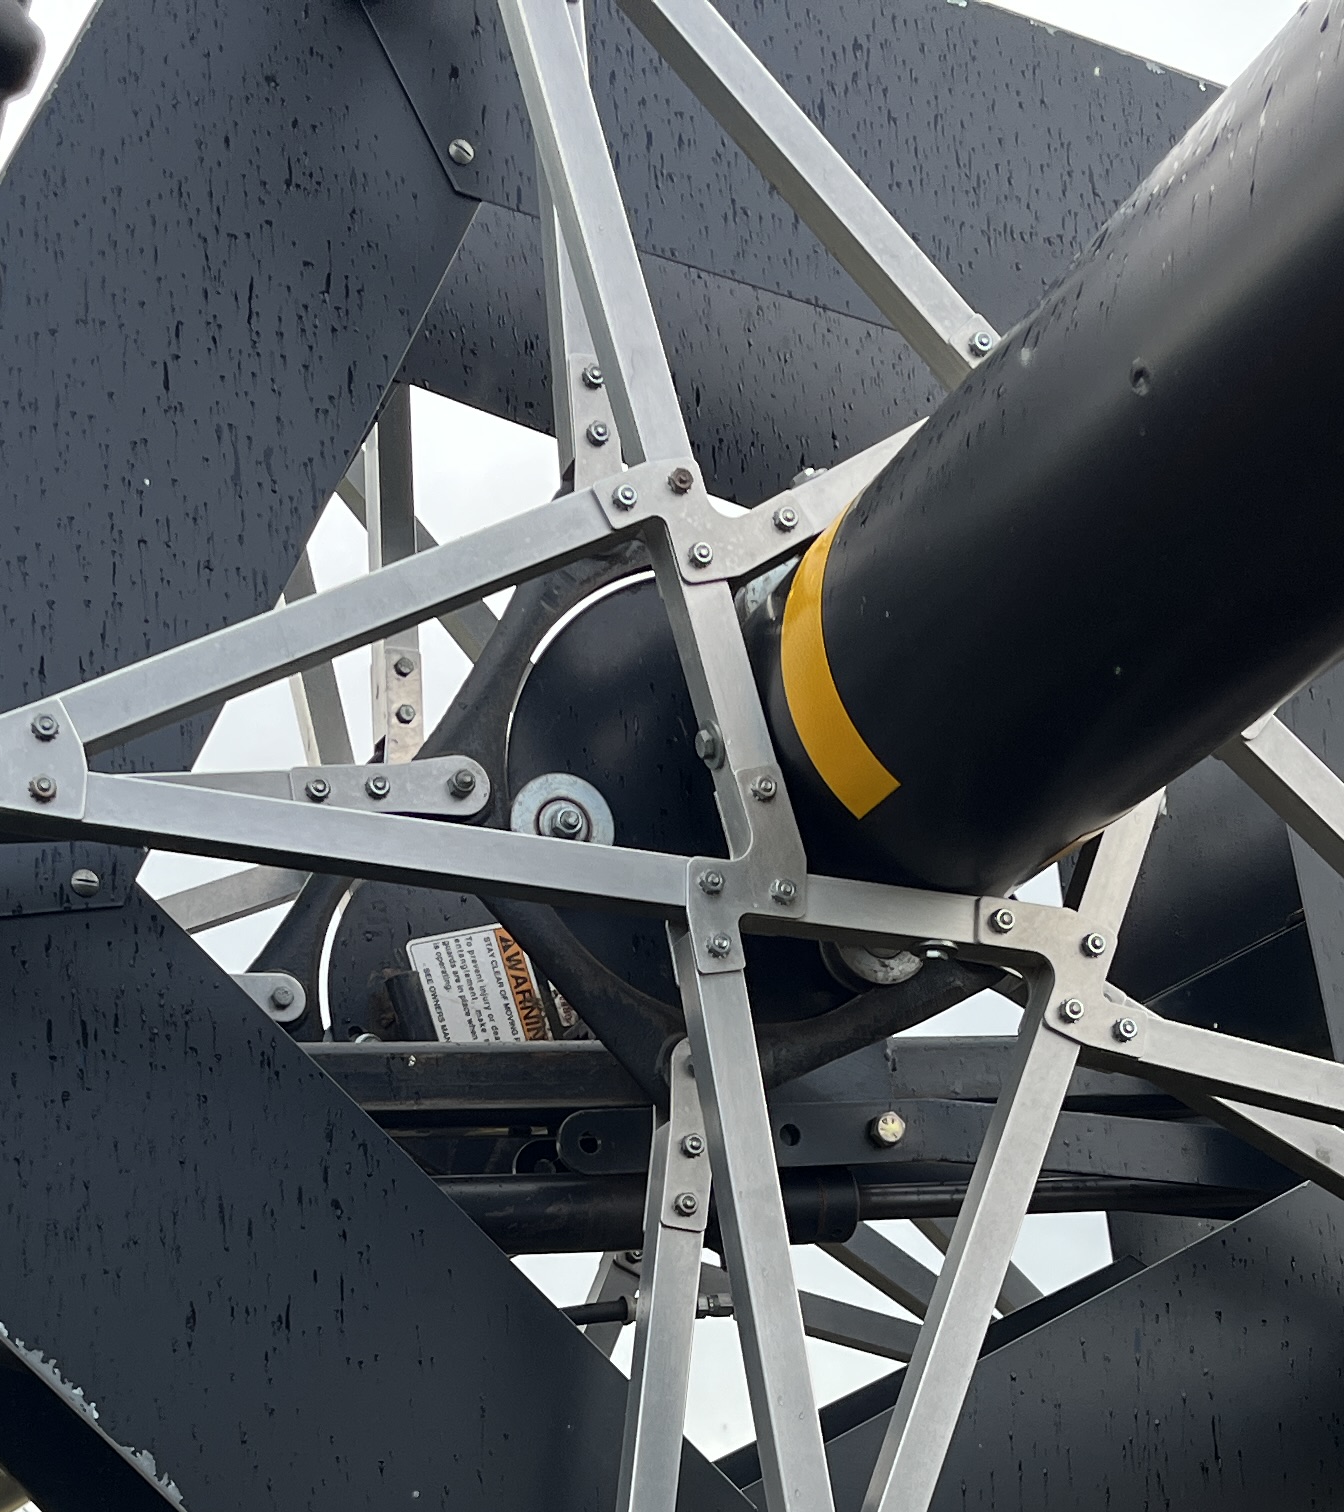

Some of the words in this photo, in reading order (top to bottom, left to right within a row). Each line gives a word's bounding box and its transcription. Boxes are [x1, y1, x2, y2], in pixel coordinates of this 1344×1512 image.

[433, 941, 441, 950] is
[465, 936, 474, 948] To
[483, 936, 496, 959] STAY
[442, 940, 458, 969] guards
[467, 949, 484, 983] prevent
[434, 951, 454, 993] operating.
[452, 970, 461, 983] are
[490, 959, 505, 988] CLEAR
[423, 967, 434, 985] SEE
[429, 985, 446, 1023] OWNERS
[457, 984, 465, 993] in
[478, 985, 493, 1011] injury
[499, 989, 509, 1001] OF
[458, 994, 472, 1017] place
[467, 1018, 479, 1041] when
[475, 1009, 488, 1033] make
[487, 1013, 495, 1023] or
[503, 1002, 519, 1036] MOVING
